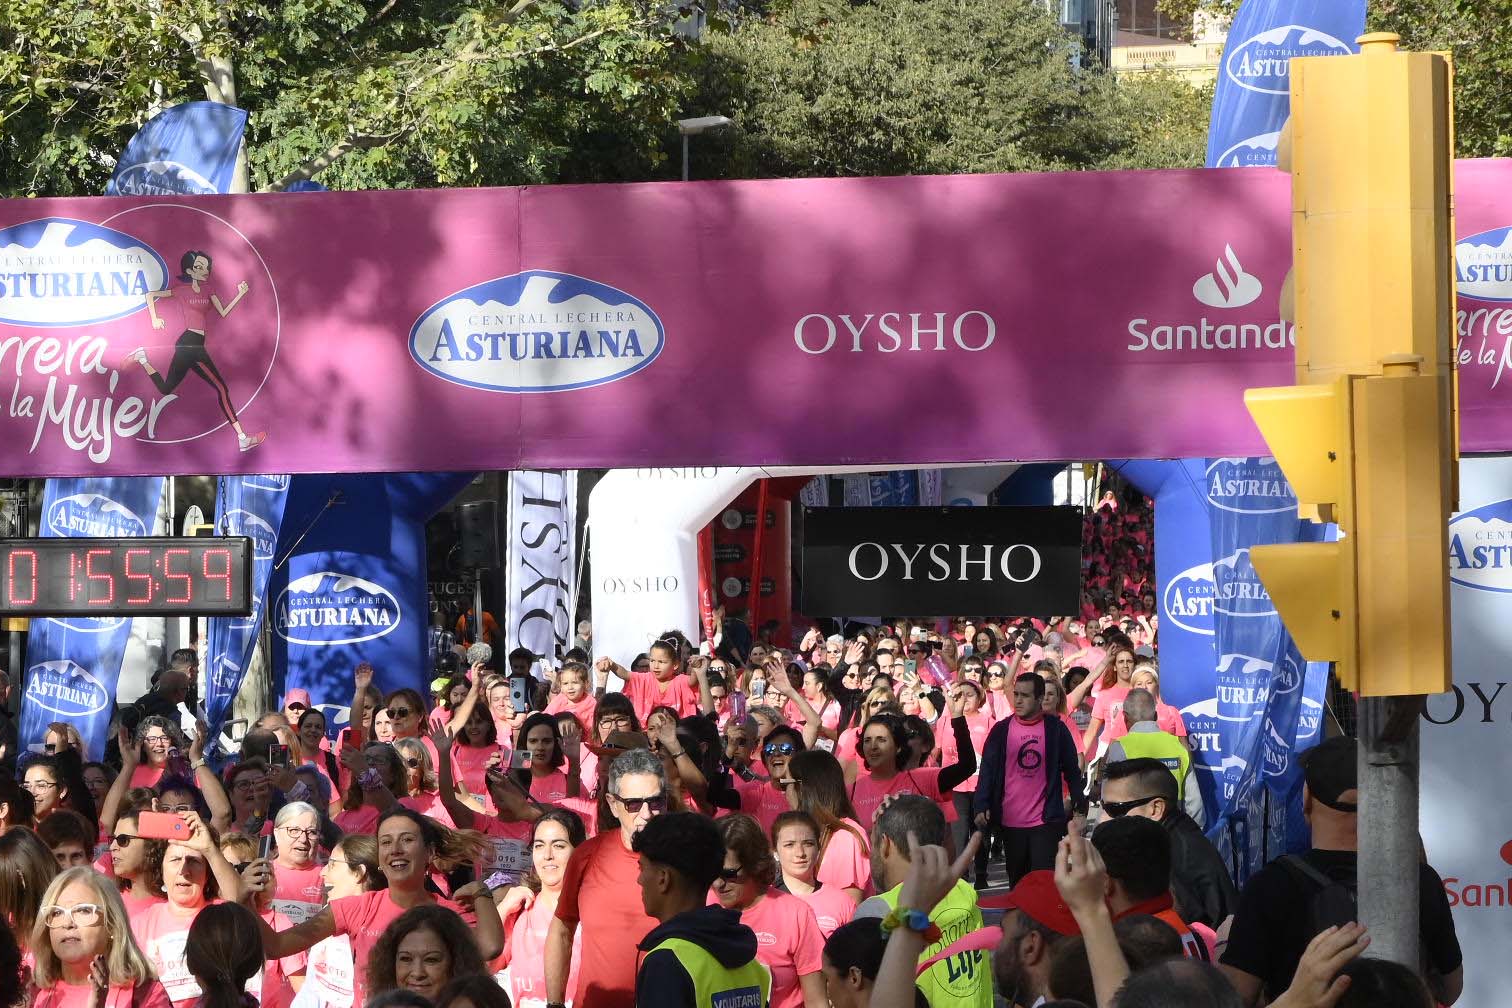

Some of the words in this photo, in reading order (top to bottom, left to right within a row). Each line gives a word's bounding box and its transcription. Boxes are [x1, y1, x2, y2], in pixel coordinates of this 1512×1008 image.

[468, 313, 548, 326] CENTRAL
[555, 312, 636, 324] LECHERA
[794, 310, 997, 355] OYSHO
[429, 318, 644, 362] ASTURIANA
[1128, 318, 1296, 350] Santand
[1477, 338, 1496, 365] la
[9, 378, 34, 417] la
[29, 369, 179, 463] Mujer
[848, 542, 1042, 583] OYSHO
[602, 576, 678, 595] OYSHO
[278, 601, 391, 628] ASTURIANA
[290, 597, 333, 606] CENTRAL
[1189, 721, 1217, 730] CENT
